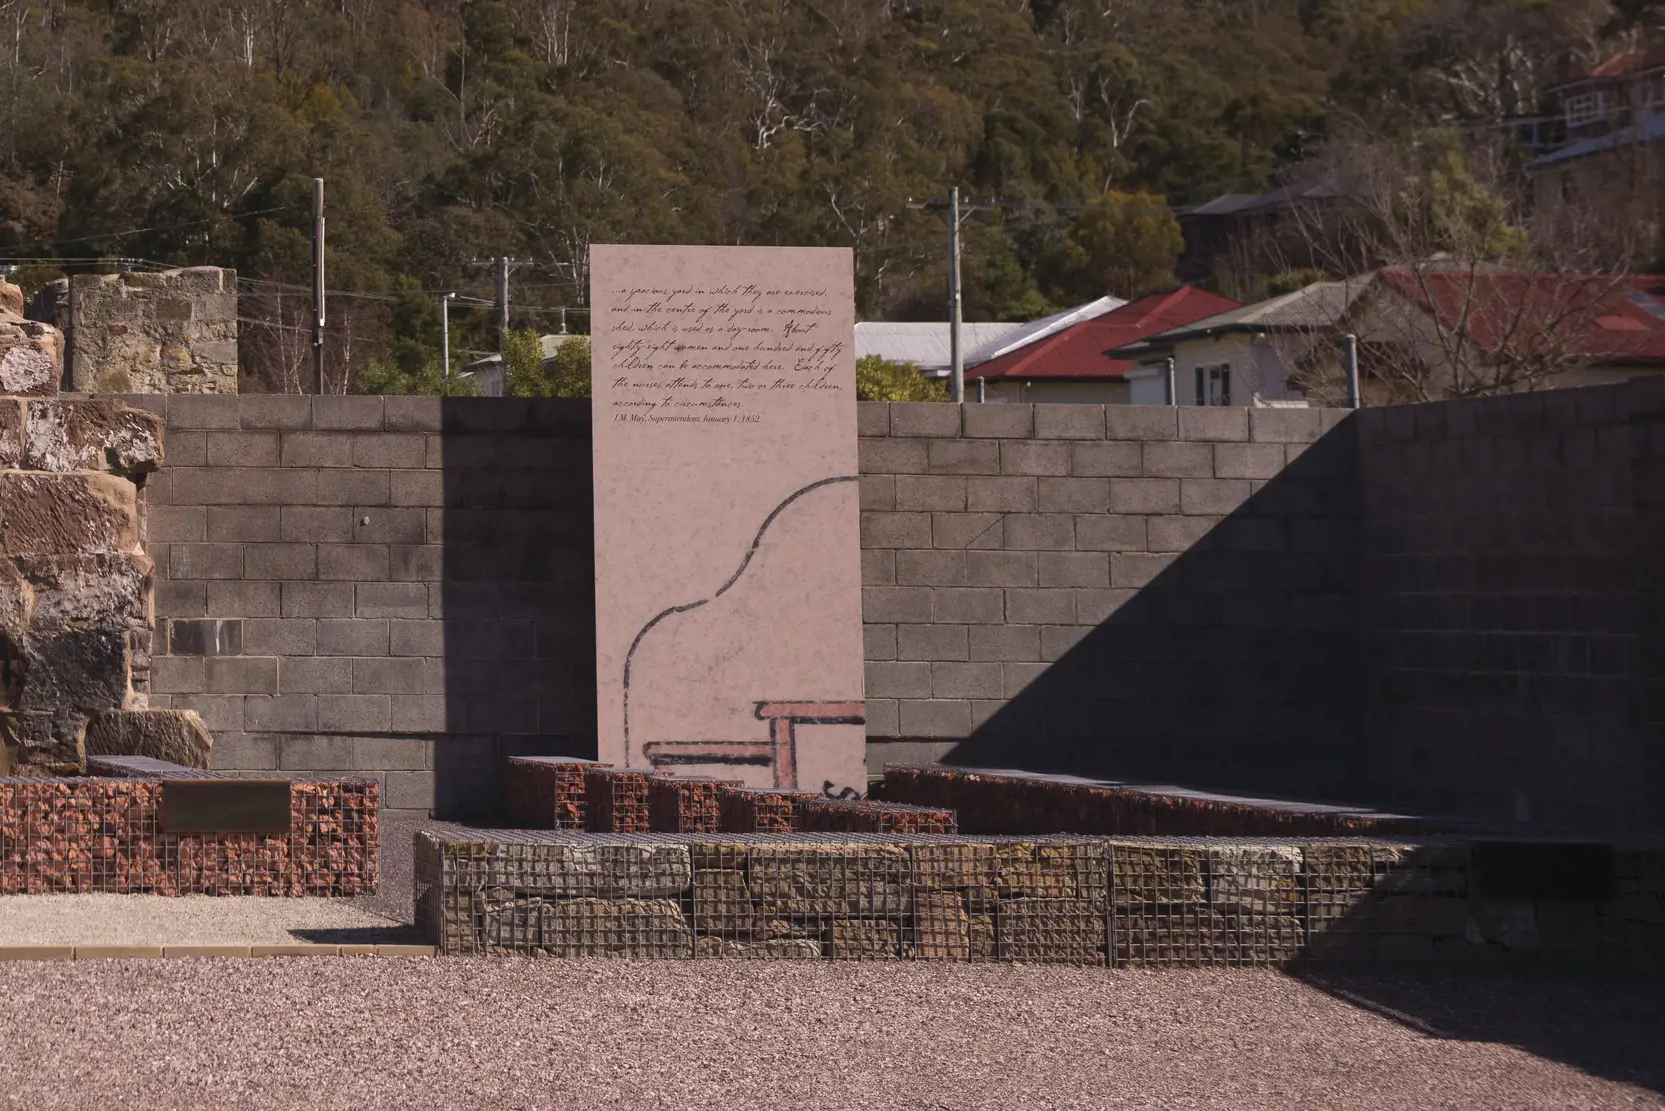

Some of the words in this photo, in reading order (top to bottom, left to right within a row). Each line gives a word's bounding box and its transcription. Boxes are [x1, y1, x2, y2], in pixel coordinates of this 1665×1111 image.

[625, 287, 668, 302] spacious
[665, 285, 693, 302] yard
[709, 285, 741, 295] which
[741, 285, 761, 303] they
[611, 303, 630, 312] and
[646, 302, 662, 313] the
[666, 302, 696, 313] centre
[696, 306, 712, 323] of
[714, 302, 730, 314] the
[728, 305, 754, 321] yard
[757, 306, 763, 315] is
[777, 305, 832, 316] commodious
[638, 321, 672, 331] which
[682, 322, 703, 333] used
[783, 319, 818, 338] About
[610, 339, 676, 360] eighty-eight
[674, 344, 707, 352] women
[712, 342, 732, 351] and
[754, 341, 793, 351] hundred
[795, 343, 814, 351] and
[808, 341, 847, 361] fifty
[612, 357, 653, 369] children
[679, 359, 688, 369] be
[692, 360, 760, 370] accommodated
[794, 358, 824, 371] Each
[822, 364, 838, 379] of
[612, 377, 628, 388] the
[665, 377, 698, 389] attends
[702, 377, 713, 389] to
[737, 378, 754, 389] two
[771, 378, 795, 389] three
[612, 397, 657, 416] according
[661, 396, 672, 407] to
[702, 414, 730, 425] January
